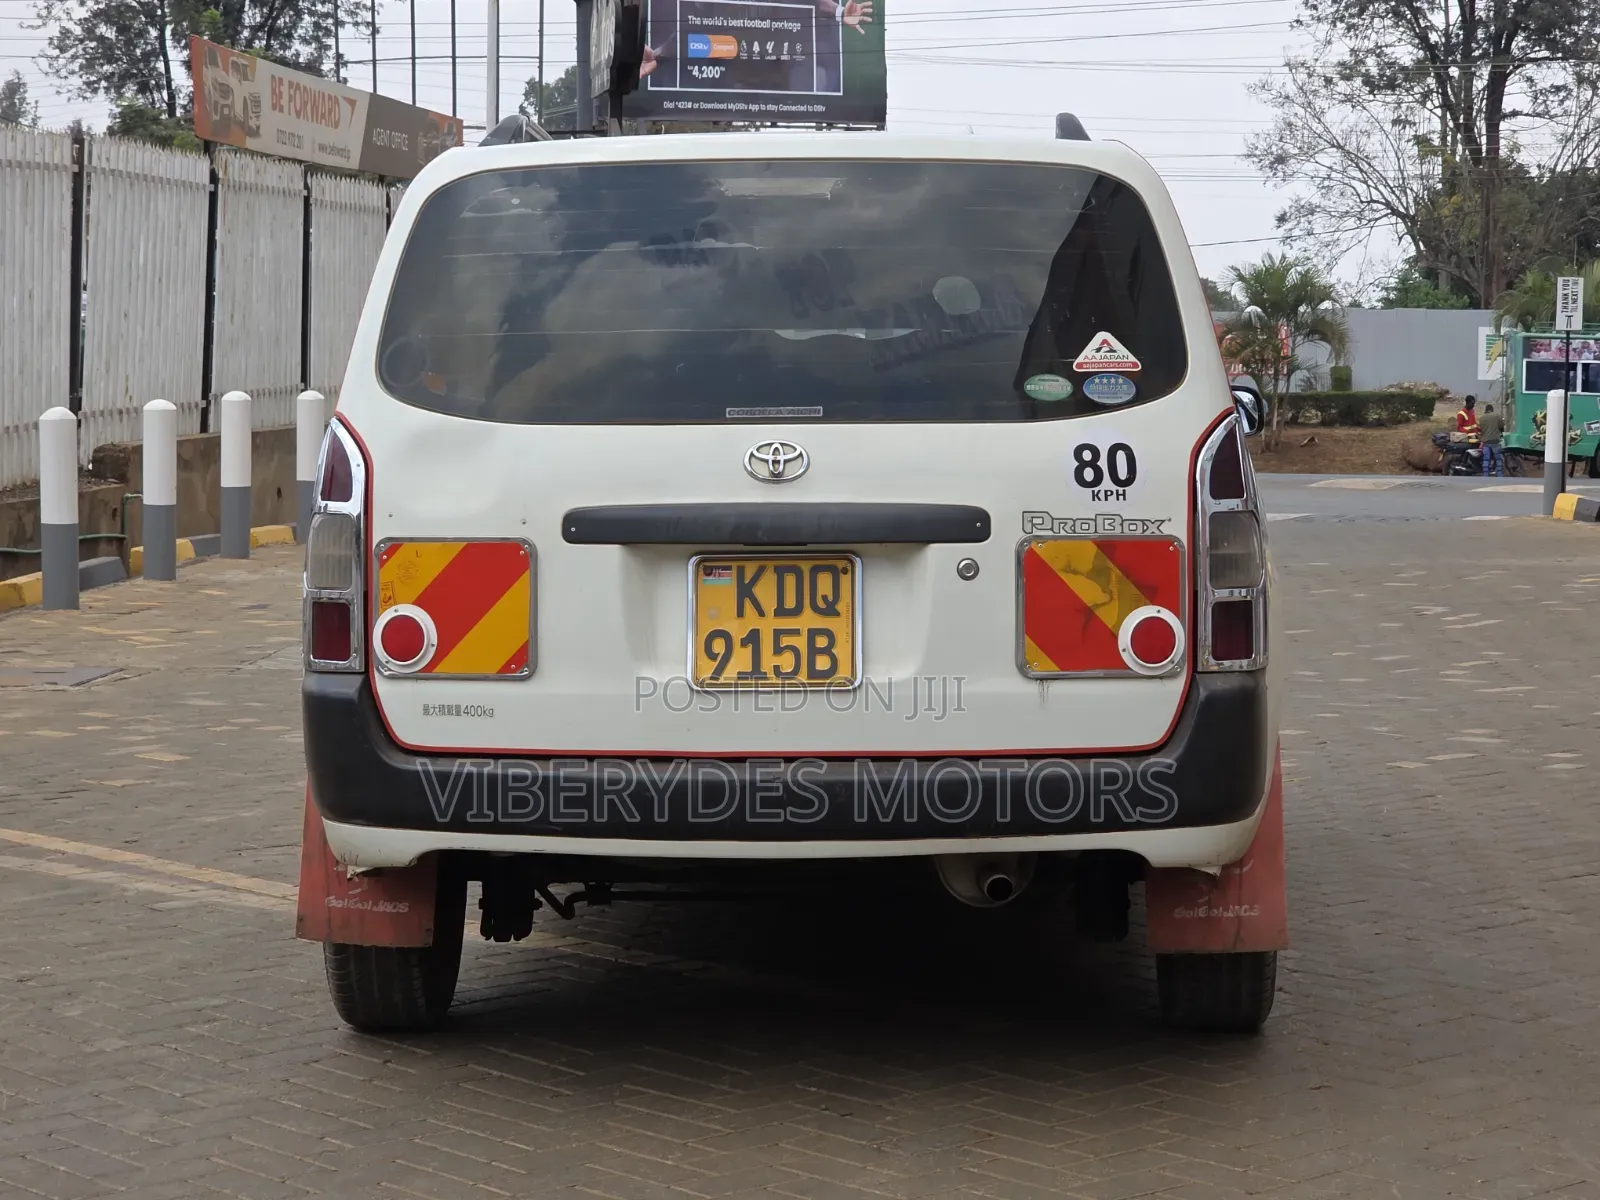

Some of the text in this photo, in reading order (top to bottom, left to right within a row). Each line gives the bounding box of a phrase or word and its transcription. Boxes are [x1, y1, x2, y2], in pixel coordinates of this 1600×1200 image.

[688, 15, 801, 32] The world's best football package
[271, 75, 341, 129] BE FORWARD
[664, 101, 674, 109] Dial
[700, 102, 727, 110] Download
[728, 102, 748, 112] MyDStv
[748, 103, 760, 112] App
[766, 104, 778, 112] stay
[372, 128, 408, 151] AGENT OFFICE
[1561, 278, 1570, 314] THANK YOU
[1082, 361, 1132, 370] aajapancars.com
[728, 408, 820, 416] COROLLA AICHI
[1073, 442, 1137, 488] 80
[1091, 489, 1126, 502] KPH
[736, 564, 840, 618] KDQ
[704, 628, 838, 681] 915B
